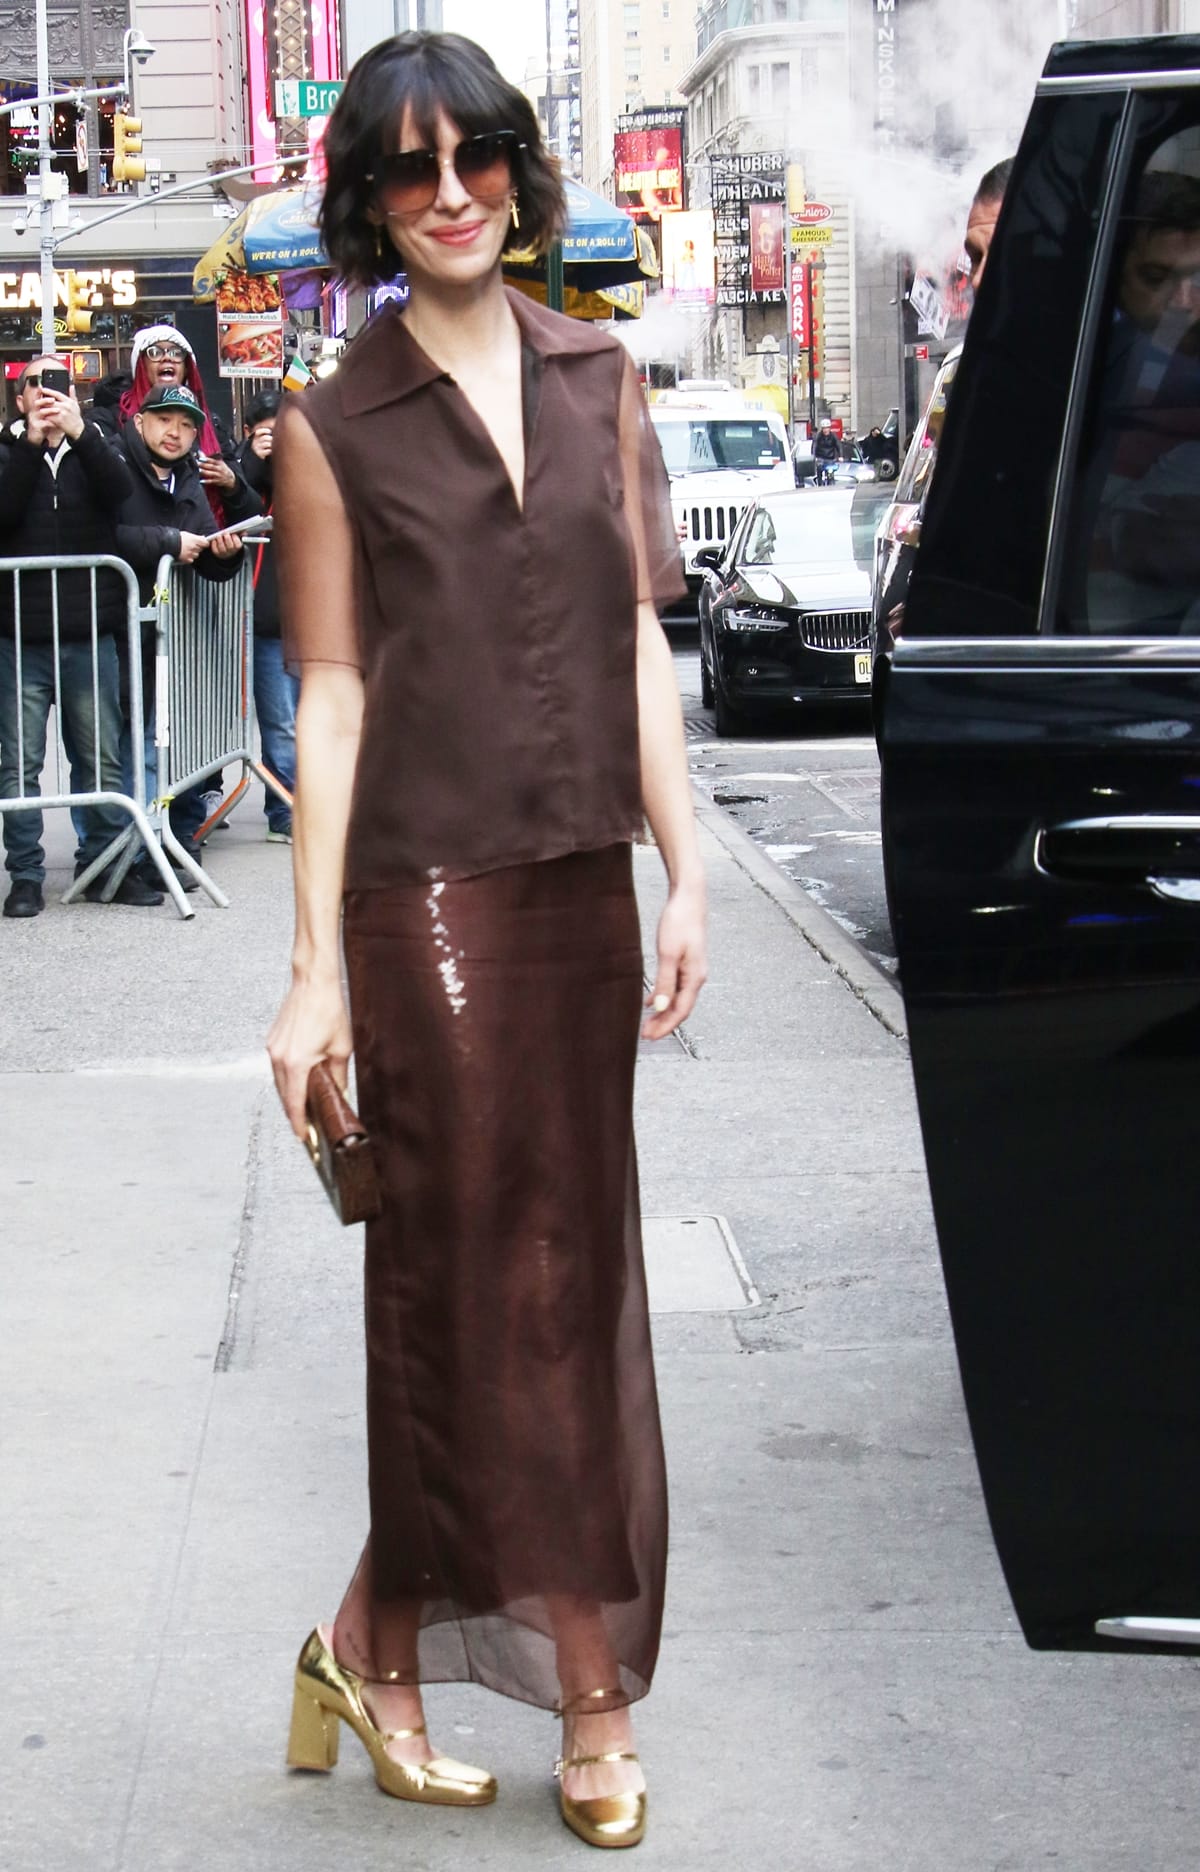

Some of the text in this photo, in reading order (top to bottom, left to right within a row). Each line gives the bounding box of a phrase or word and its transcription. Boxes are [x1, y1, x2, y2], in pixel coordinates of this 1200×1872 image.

[576, 238, 589, 248] ON
[589, 238, 597, 247] A
[597, 237, 616, 247] ROLL
[251, 246, 320, 262] WE'RE ON A ROLL
